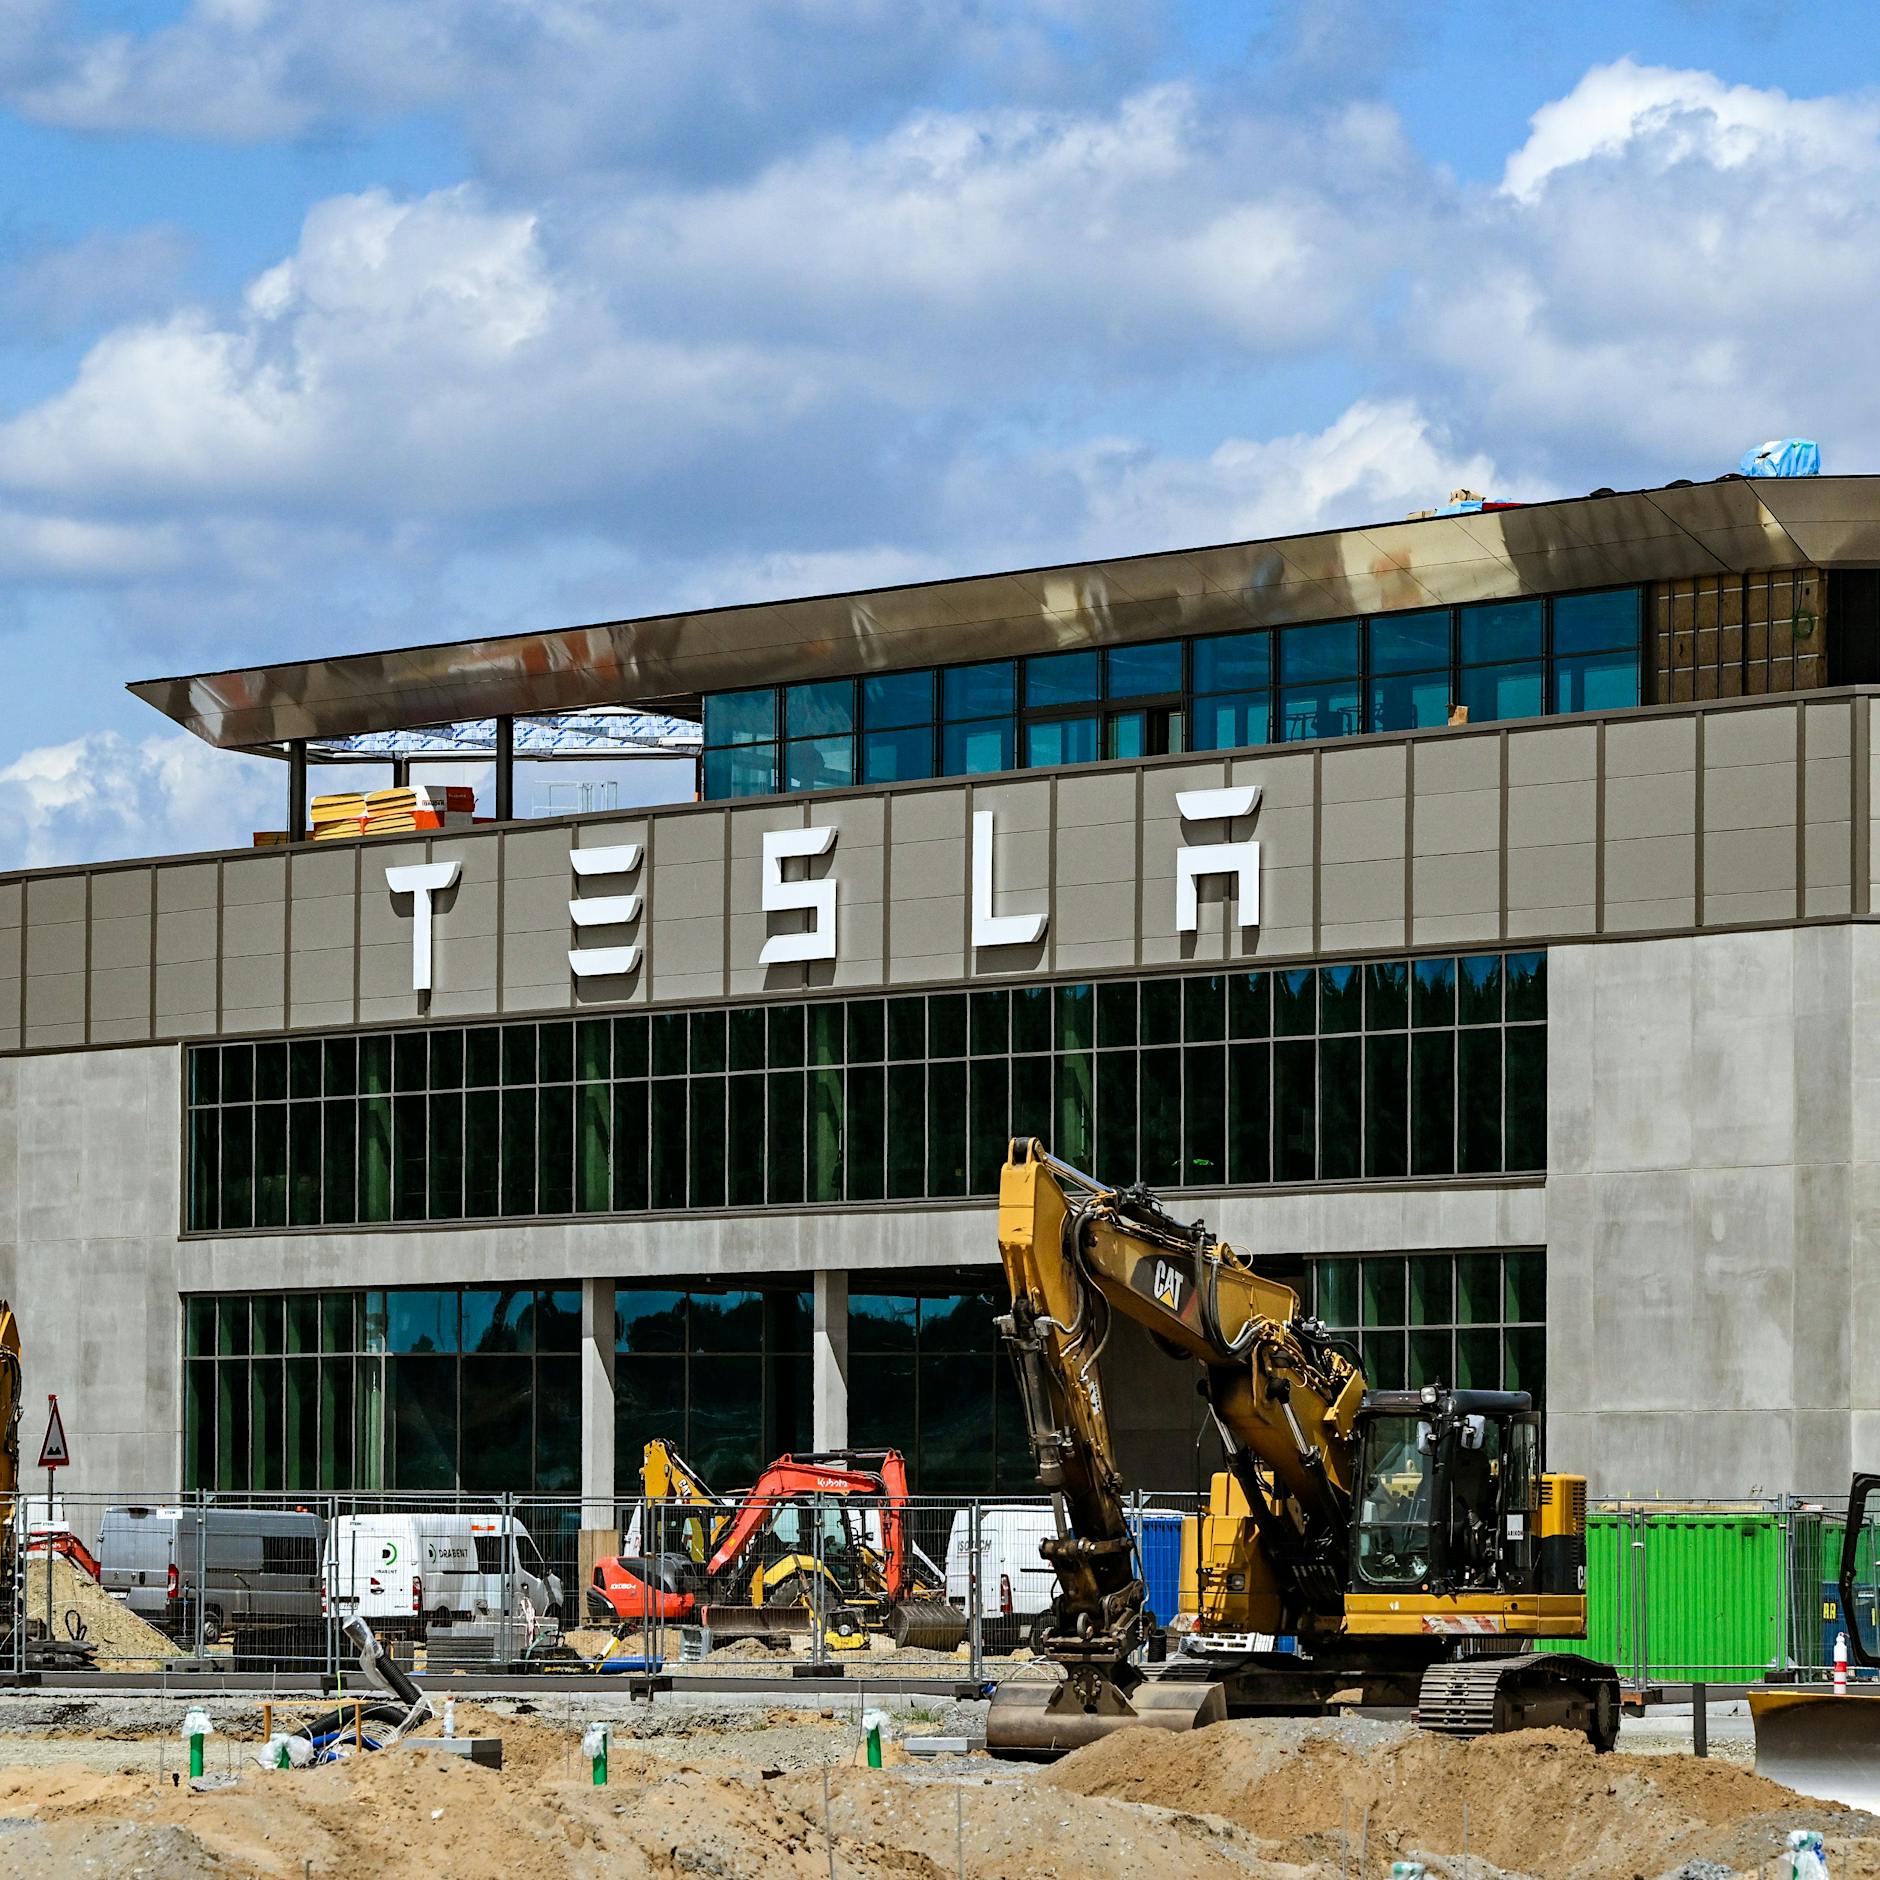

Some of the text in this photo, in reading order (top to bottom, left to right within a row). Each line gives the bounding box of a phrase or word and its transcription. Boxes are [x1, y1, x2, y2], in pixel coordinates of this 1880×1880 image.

[385, 785, 1263, 990] TESLA
[1154, 1260, 1183, 1312] CAT
[817, 1478, 848, 1487] Kubota
[438, 1549, 468, 1558] DRABENT
